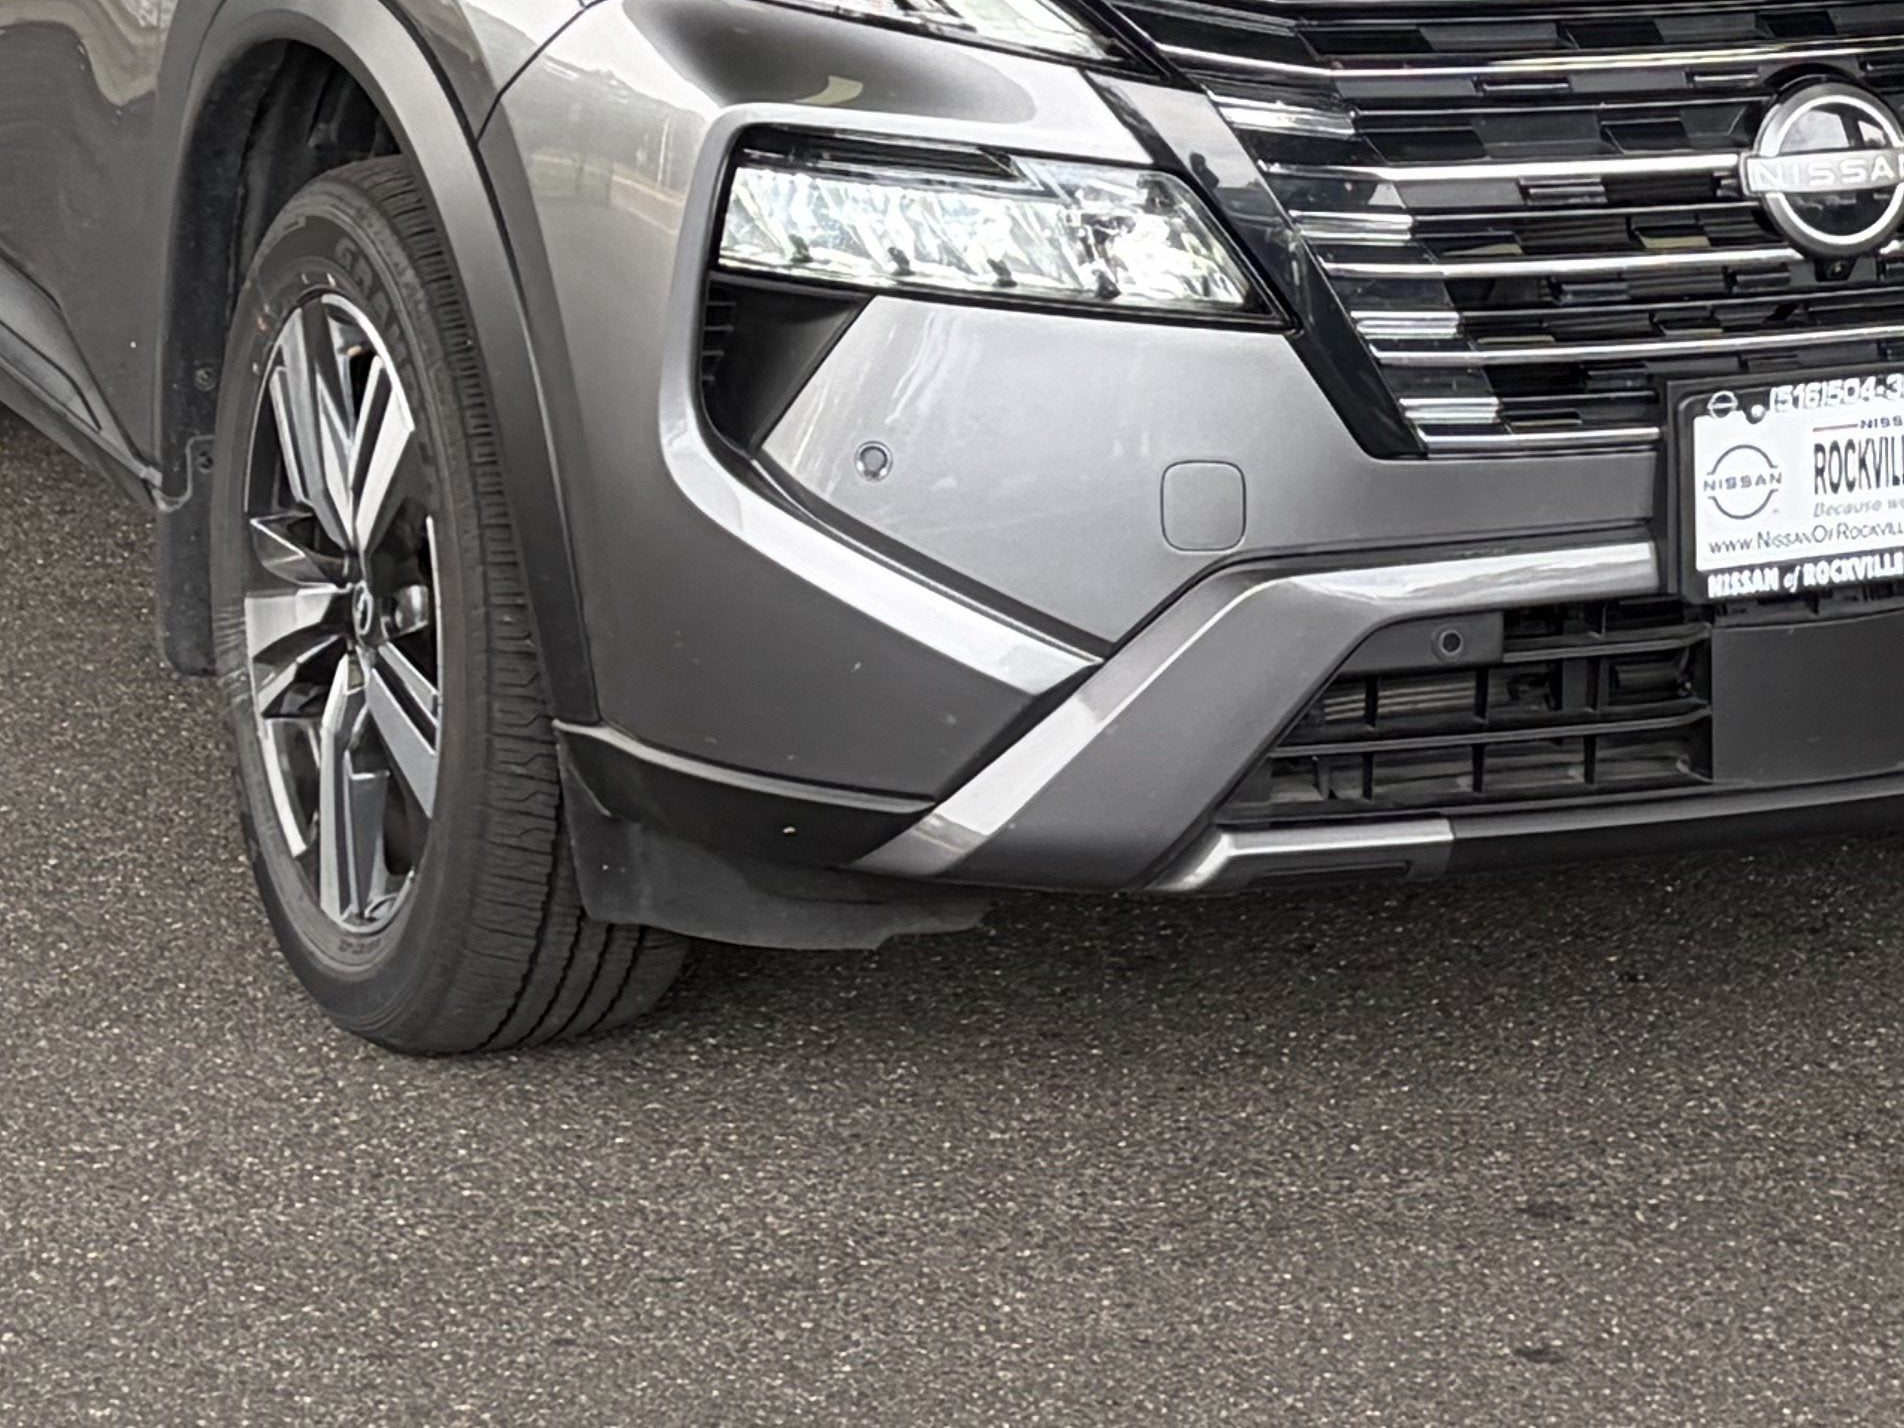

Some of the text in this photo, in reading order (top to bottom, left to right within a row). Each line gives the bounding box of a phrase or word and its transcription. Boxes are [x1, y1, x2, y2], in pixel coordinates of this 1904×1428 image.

[1703, 472, 1783, 492] NISSAN
[1813, 499, 1882, 518] Because
[1707, 566, 1780, 598] NISSAN
[1783, 565, 1801, 594] of
